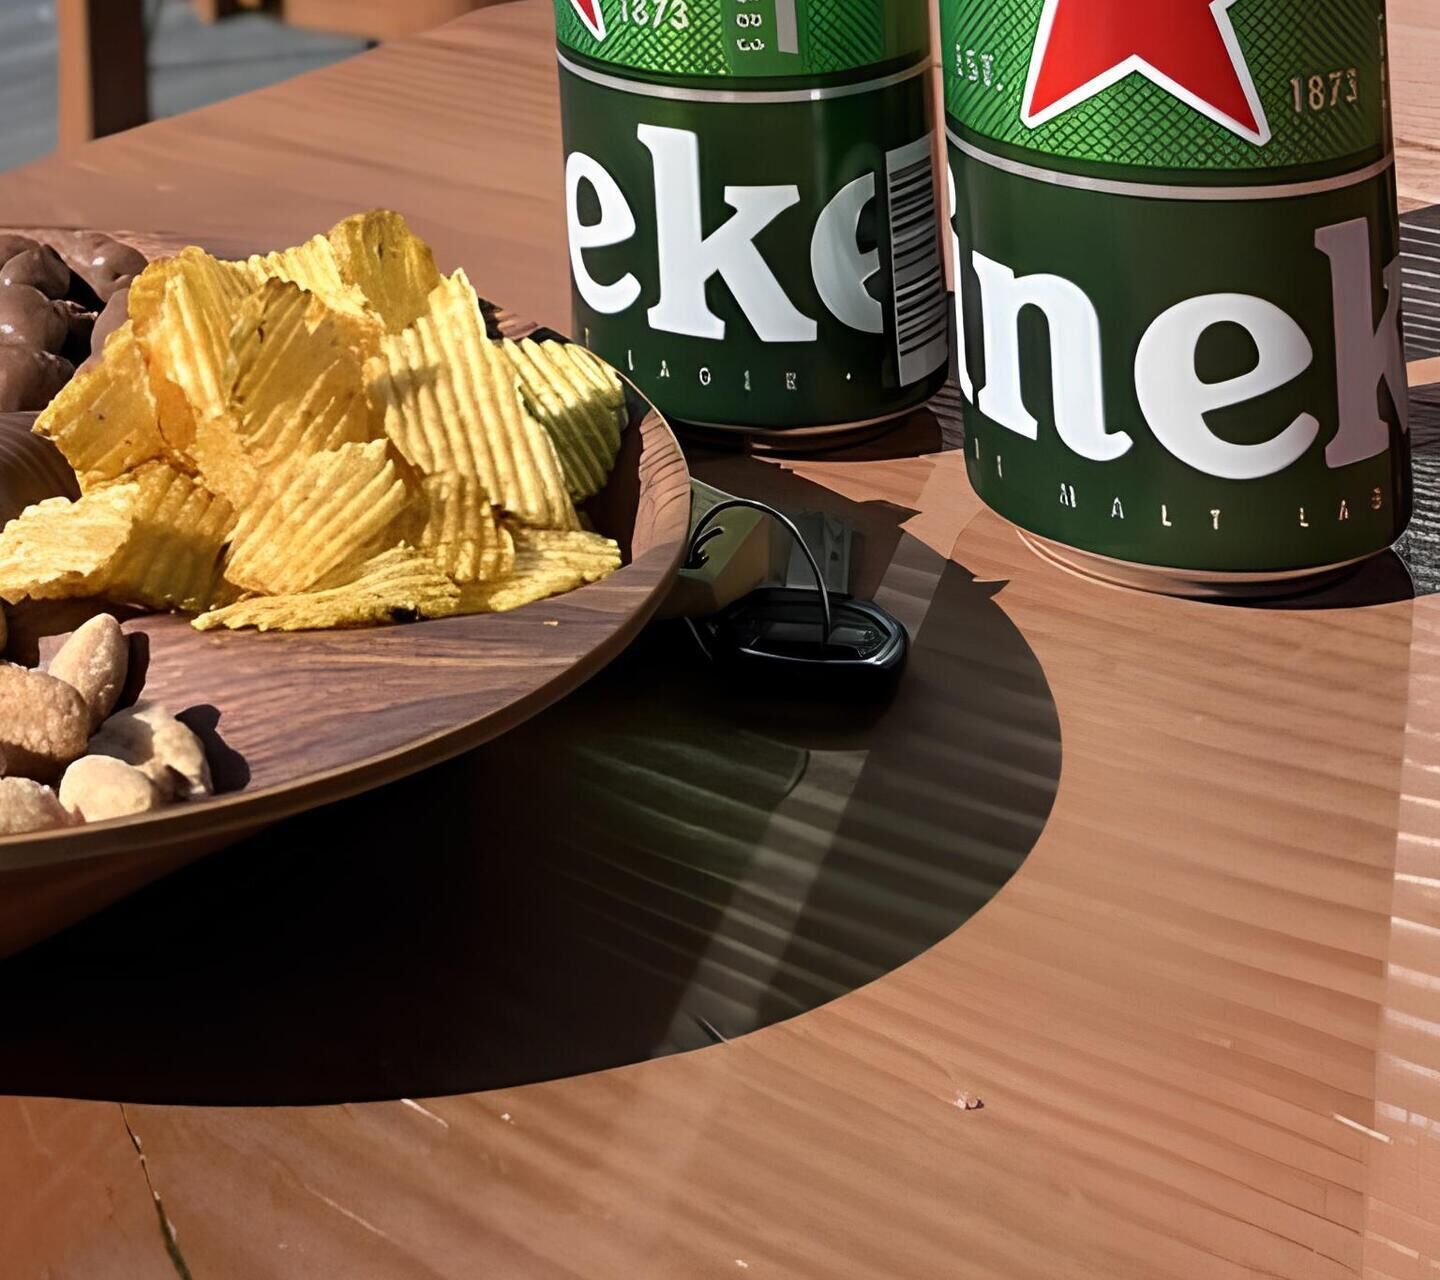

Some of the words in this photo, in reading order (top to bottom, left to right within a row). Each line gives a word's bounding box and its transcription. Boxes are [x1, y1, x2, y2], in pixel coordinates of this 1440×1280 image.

[1290, 68, 1358, 113] 1873
[564, 122, 885, 342] eke
[1059, 482, 1222, 530] MALT
